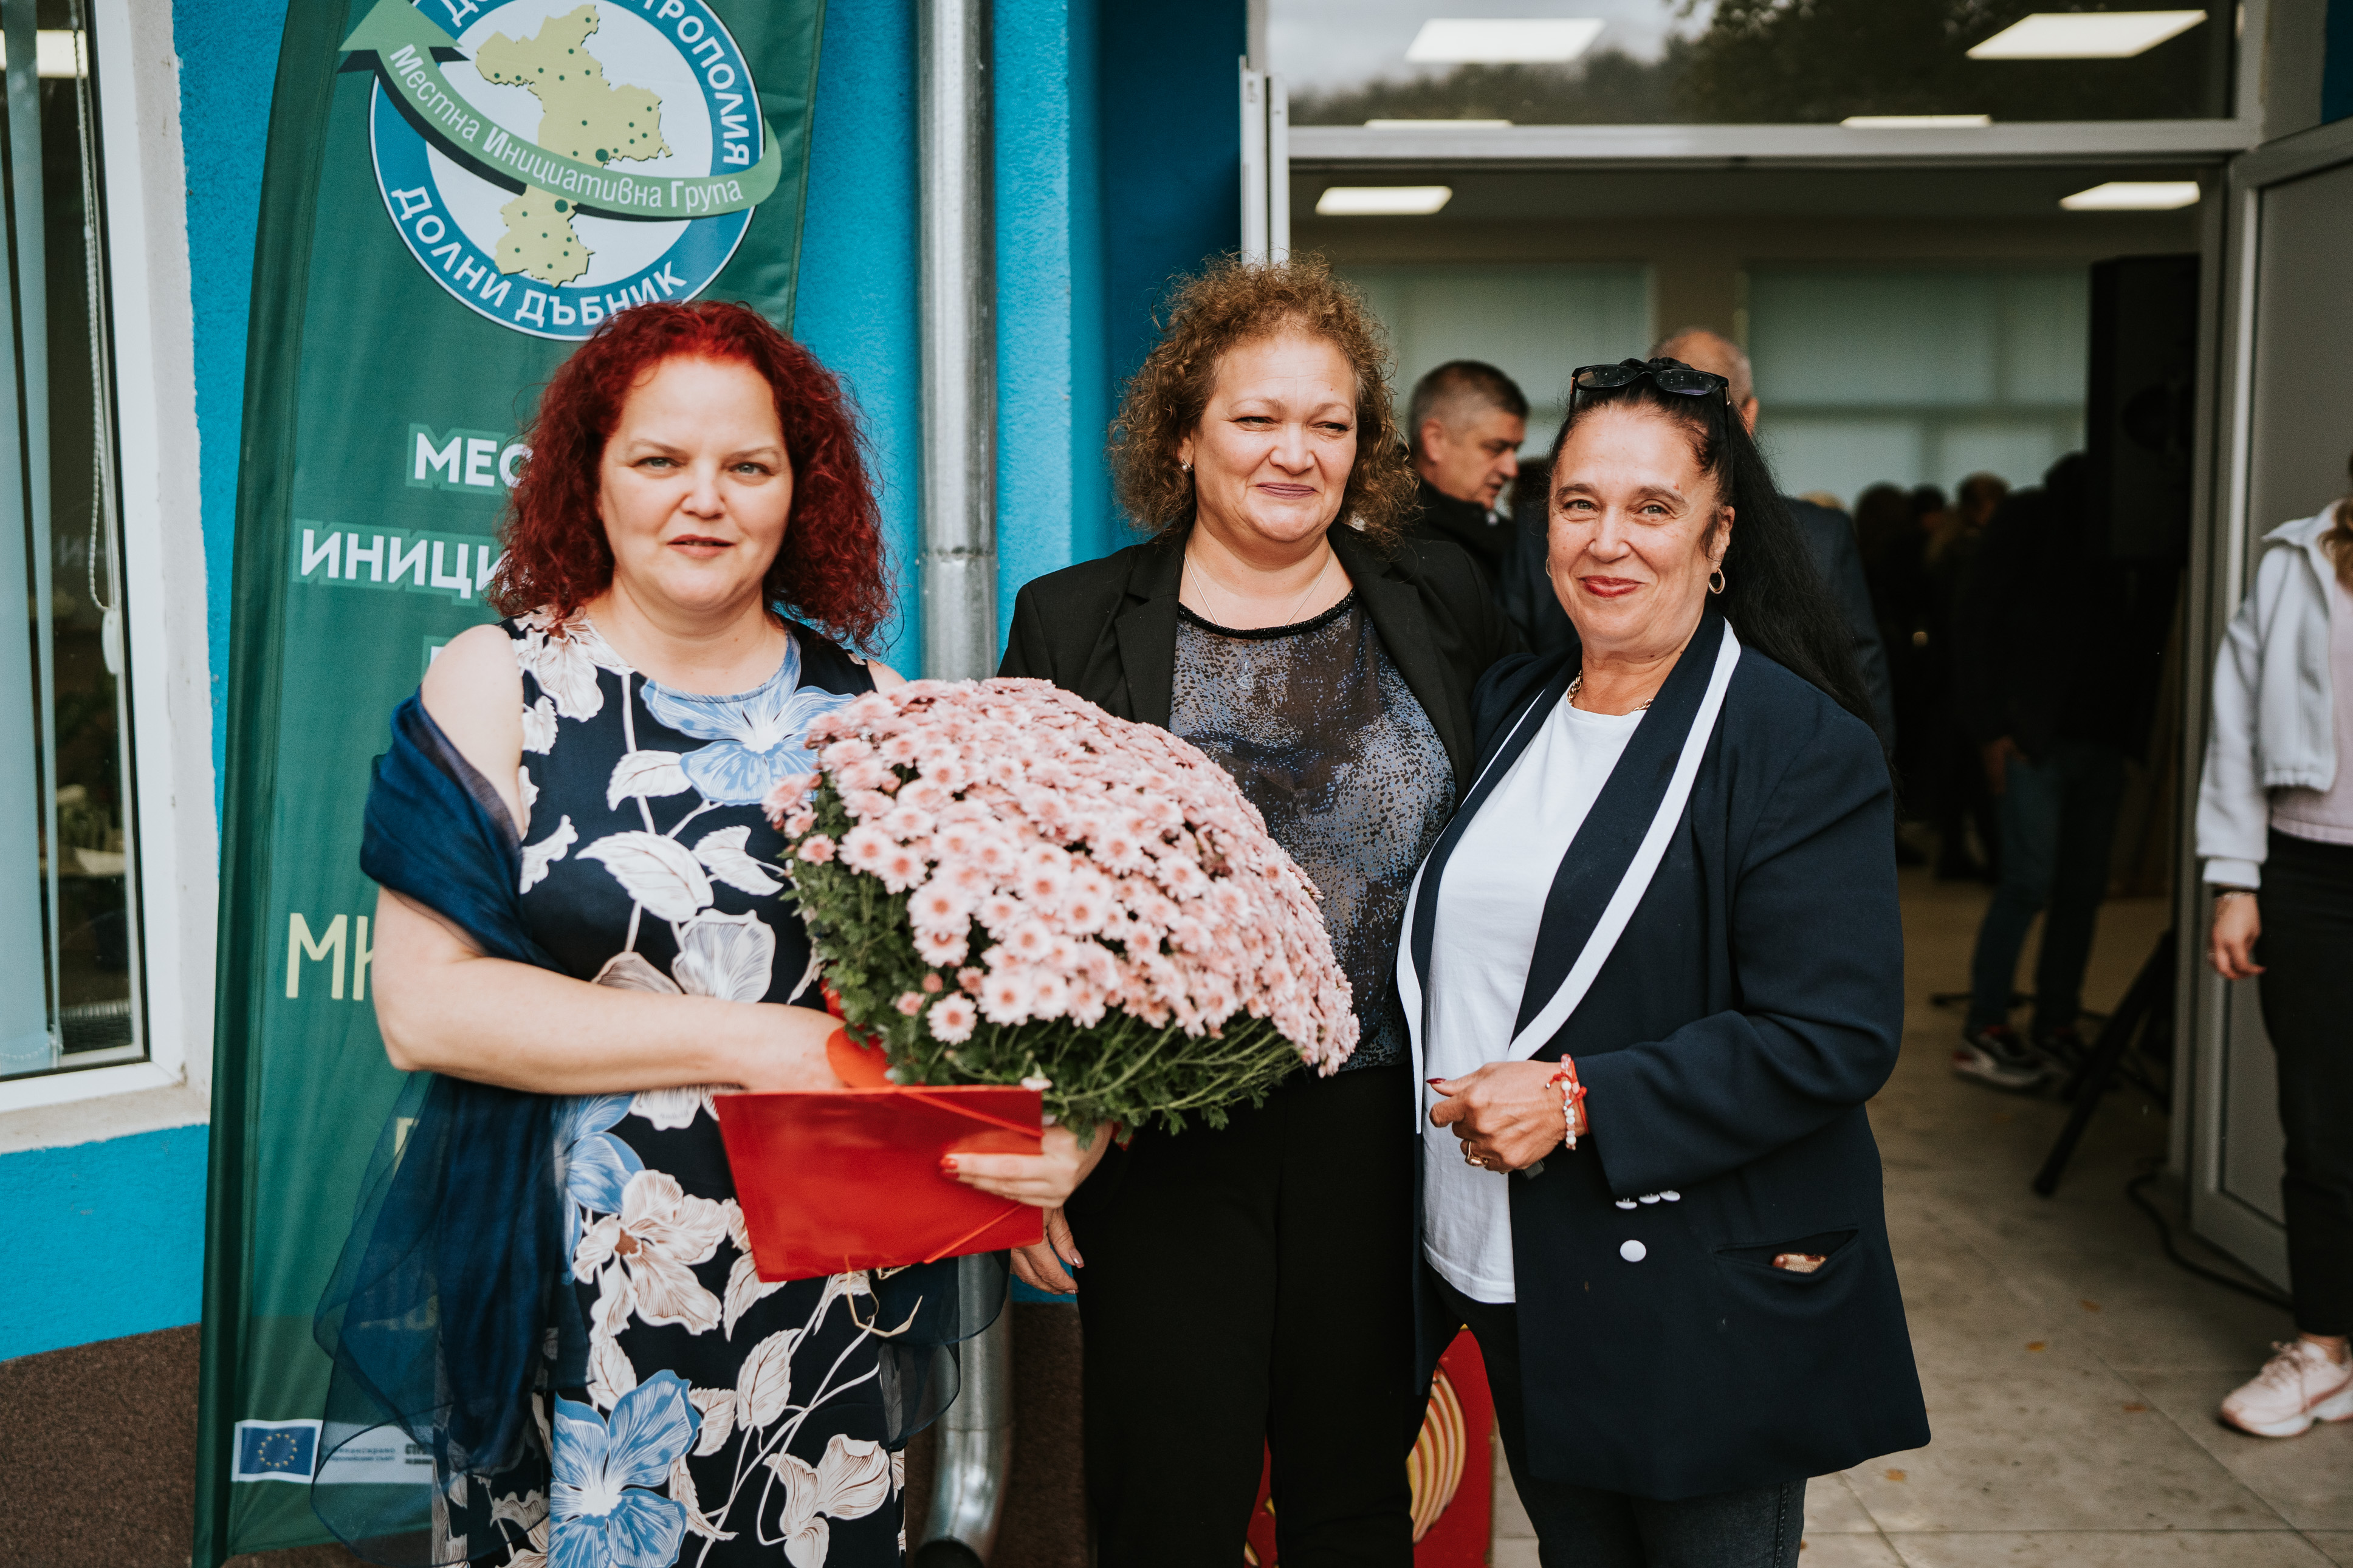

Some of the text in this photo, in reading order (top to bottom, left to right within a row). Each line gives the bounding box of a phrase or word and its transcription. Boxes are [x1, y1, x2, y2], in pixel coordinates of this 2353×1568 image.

[389, 44, 744, 213] Местна Инициативна Група
[391, 186, 687, 328] ДОЛНИ ДЪБНИК
